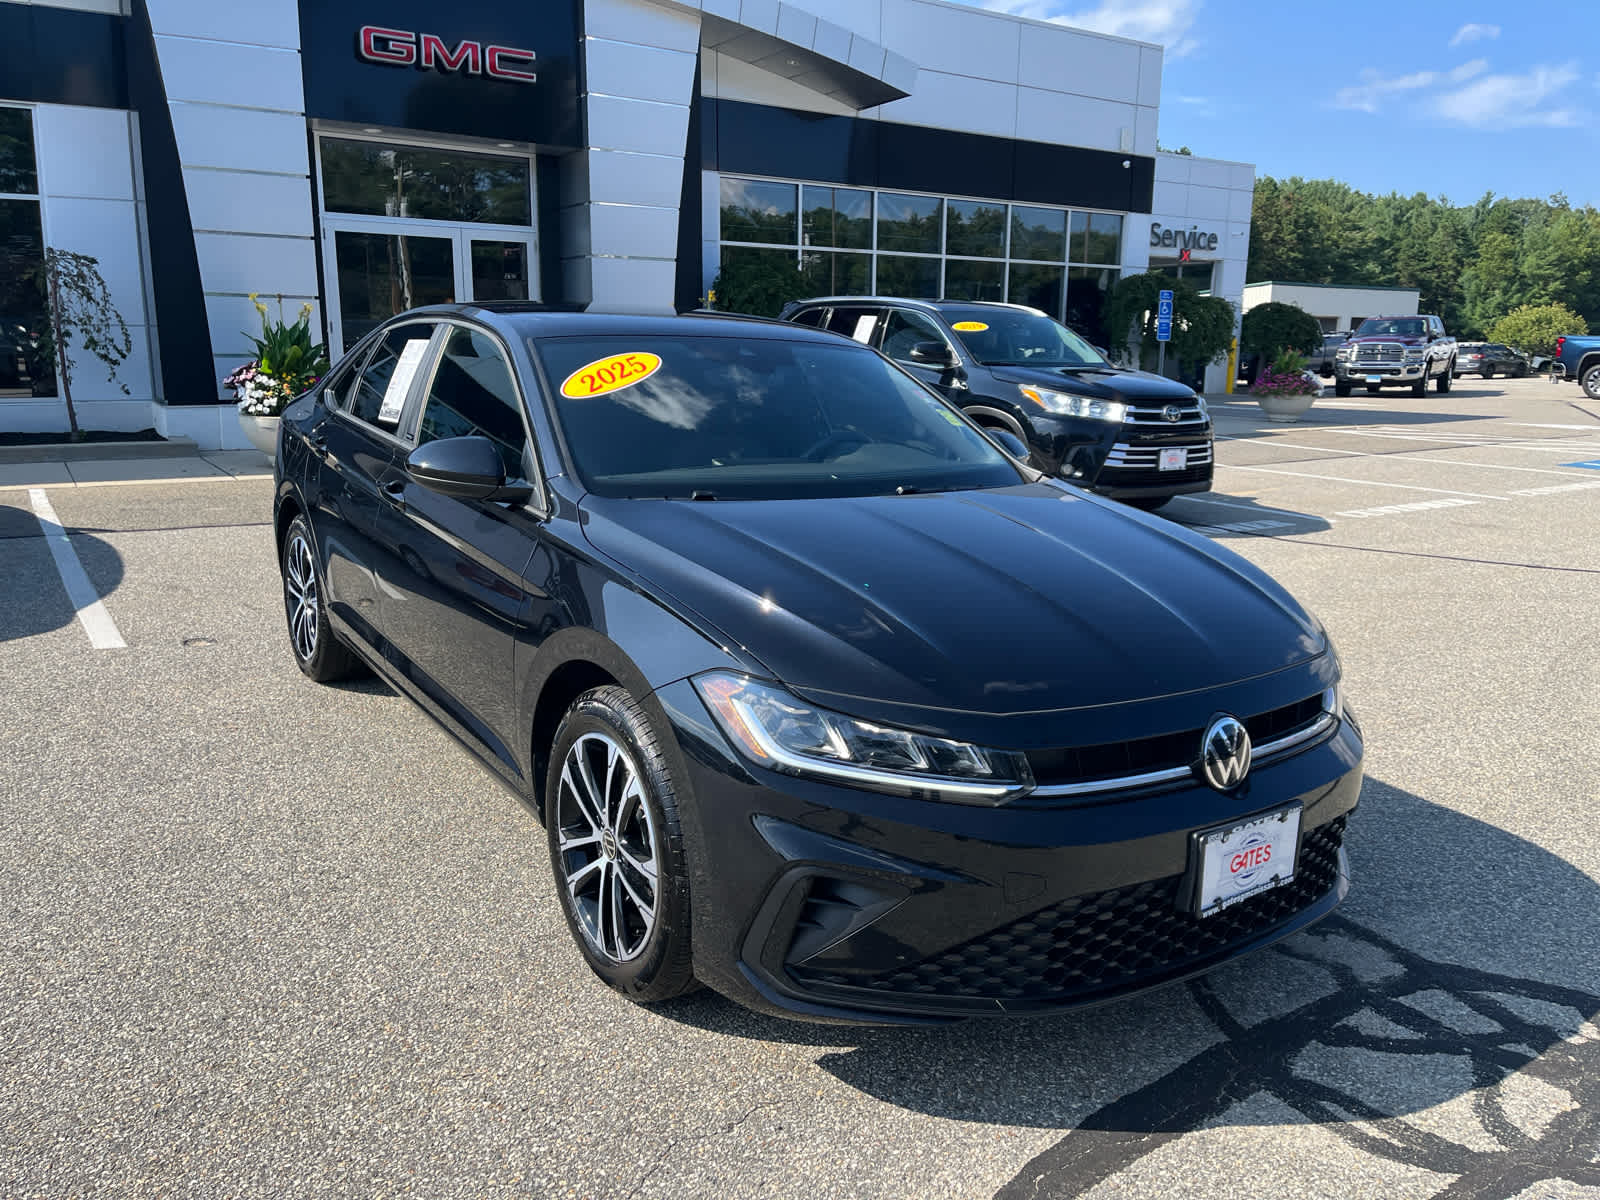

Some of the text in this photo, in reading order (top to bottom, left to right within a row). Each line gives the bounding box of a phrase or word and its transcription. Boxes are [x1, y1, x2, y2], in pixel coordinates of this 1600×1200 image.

[360, 25, 537, 83] GMC
[1150, 222, 1218, 251] Service
[580, 356, 647, 393] 2025
[1230, 844, 1272, 873] GATES
